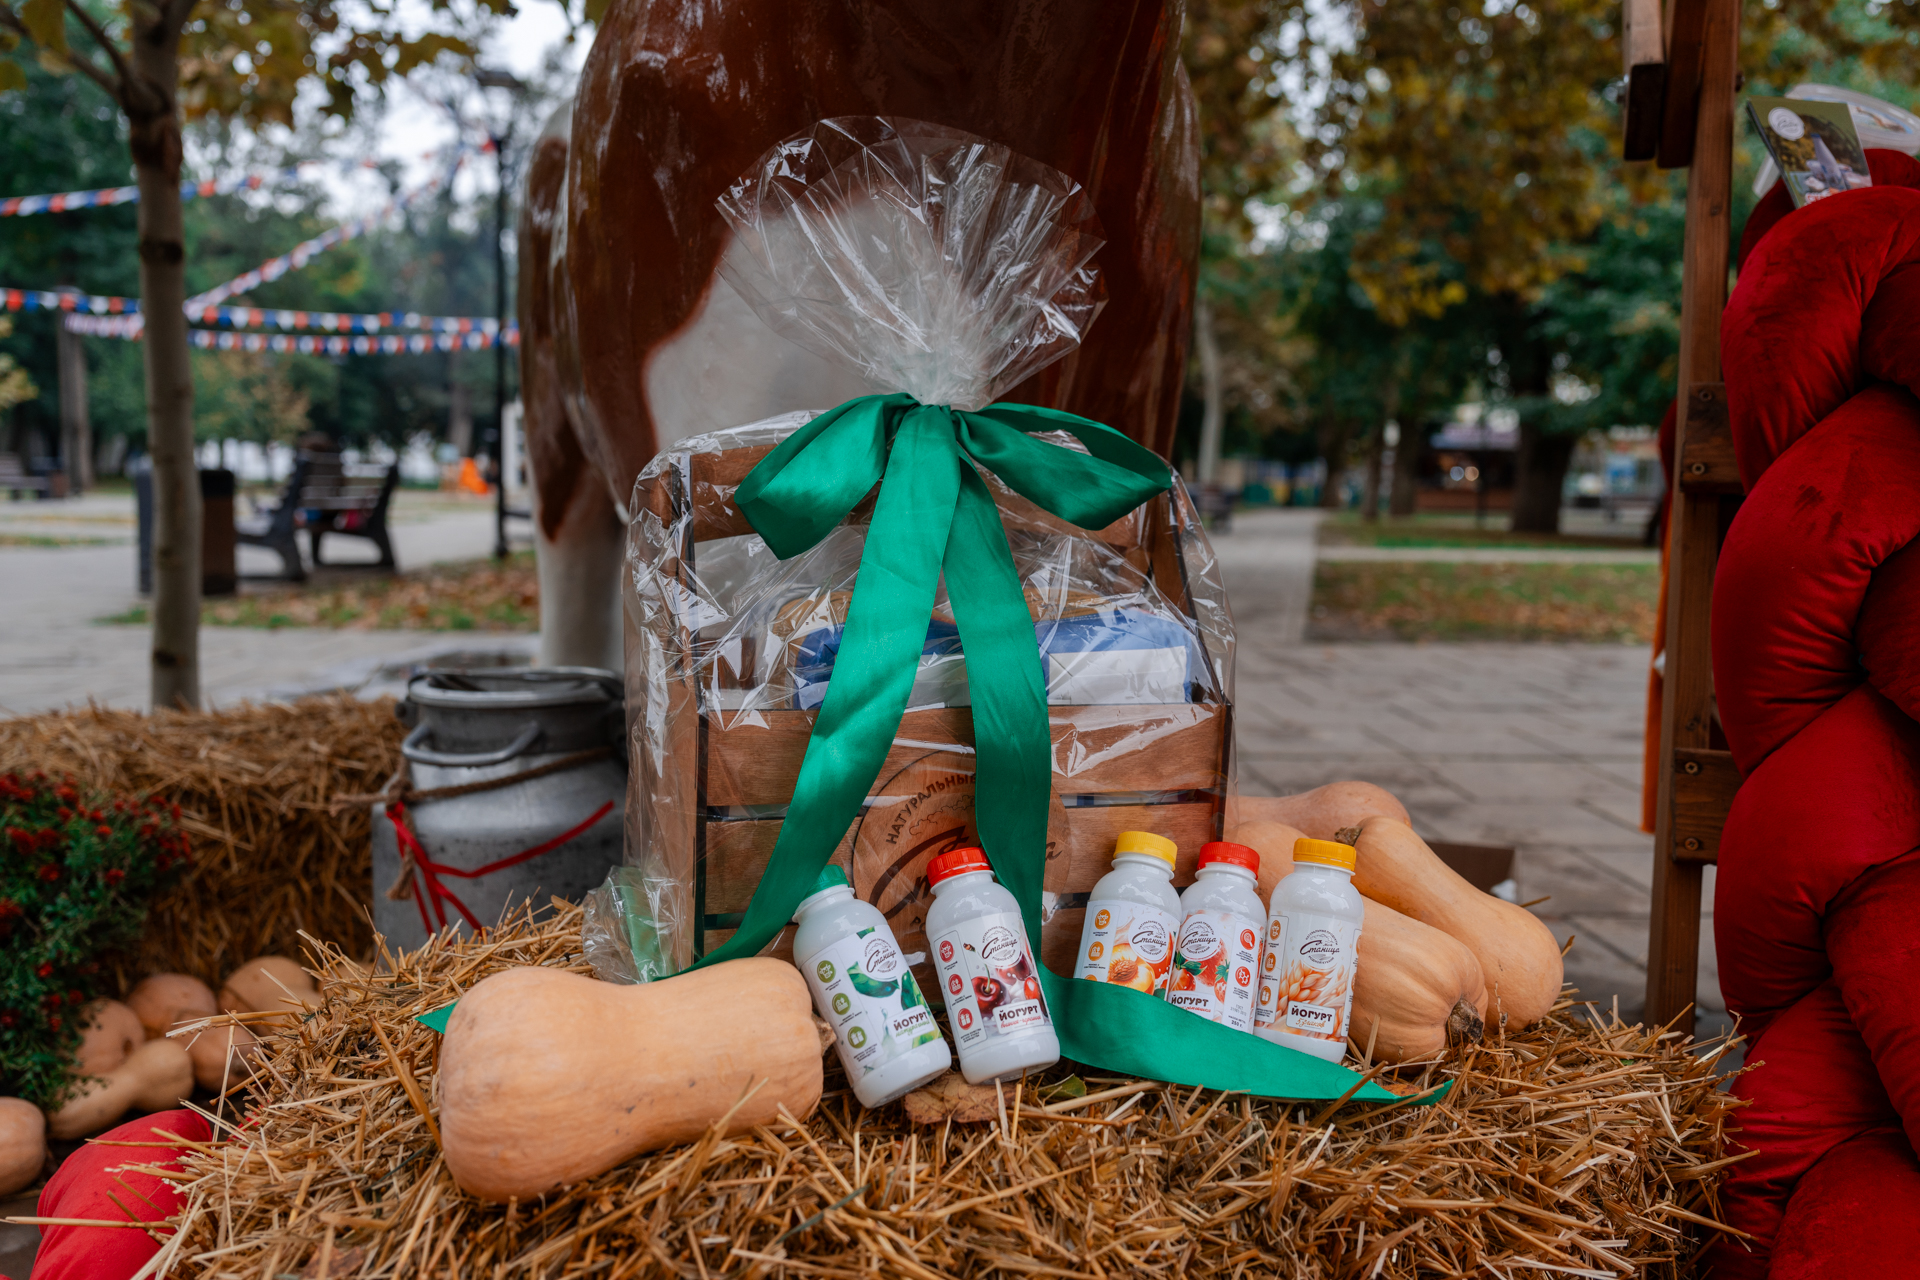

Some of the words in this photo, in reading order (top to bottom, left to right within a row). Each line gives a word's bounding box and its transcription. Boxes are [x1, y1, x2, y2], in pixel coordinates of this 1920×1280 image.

[885, 774, 976, 845] НАТУРАЛЬНЫЕ
[1180, 931, 1217, 949] Станица
[1299, 939, 1340, 955] Станица
[1171, 994, 1209, 1007] ЙОГУРТ
[893, 1011, 928, 1031] ЙОГУРТ
[999, 1005, 1038, 1021] ЙОГУРТ
[1291, 1005, 1332, 1022] ЙОГУРТ
